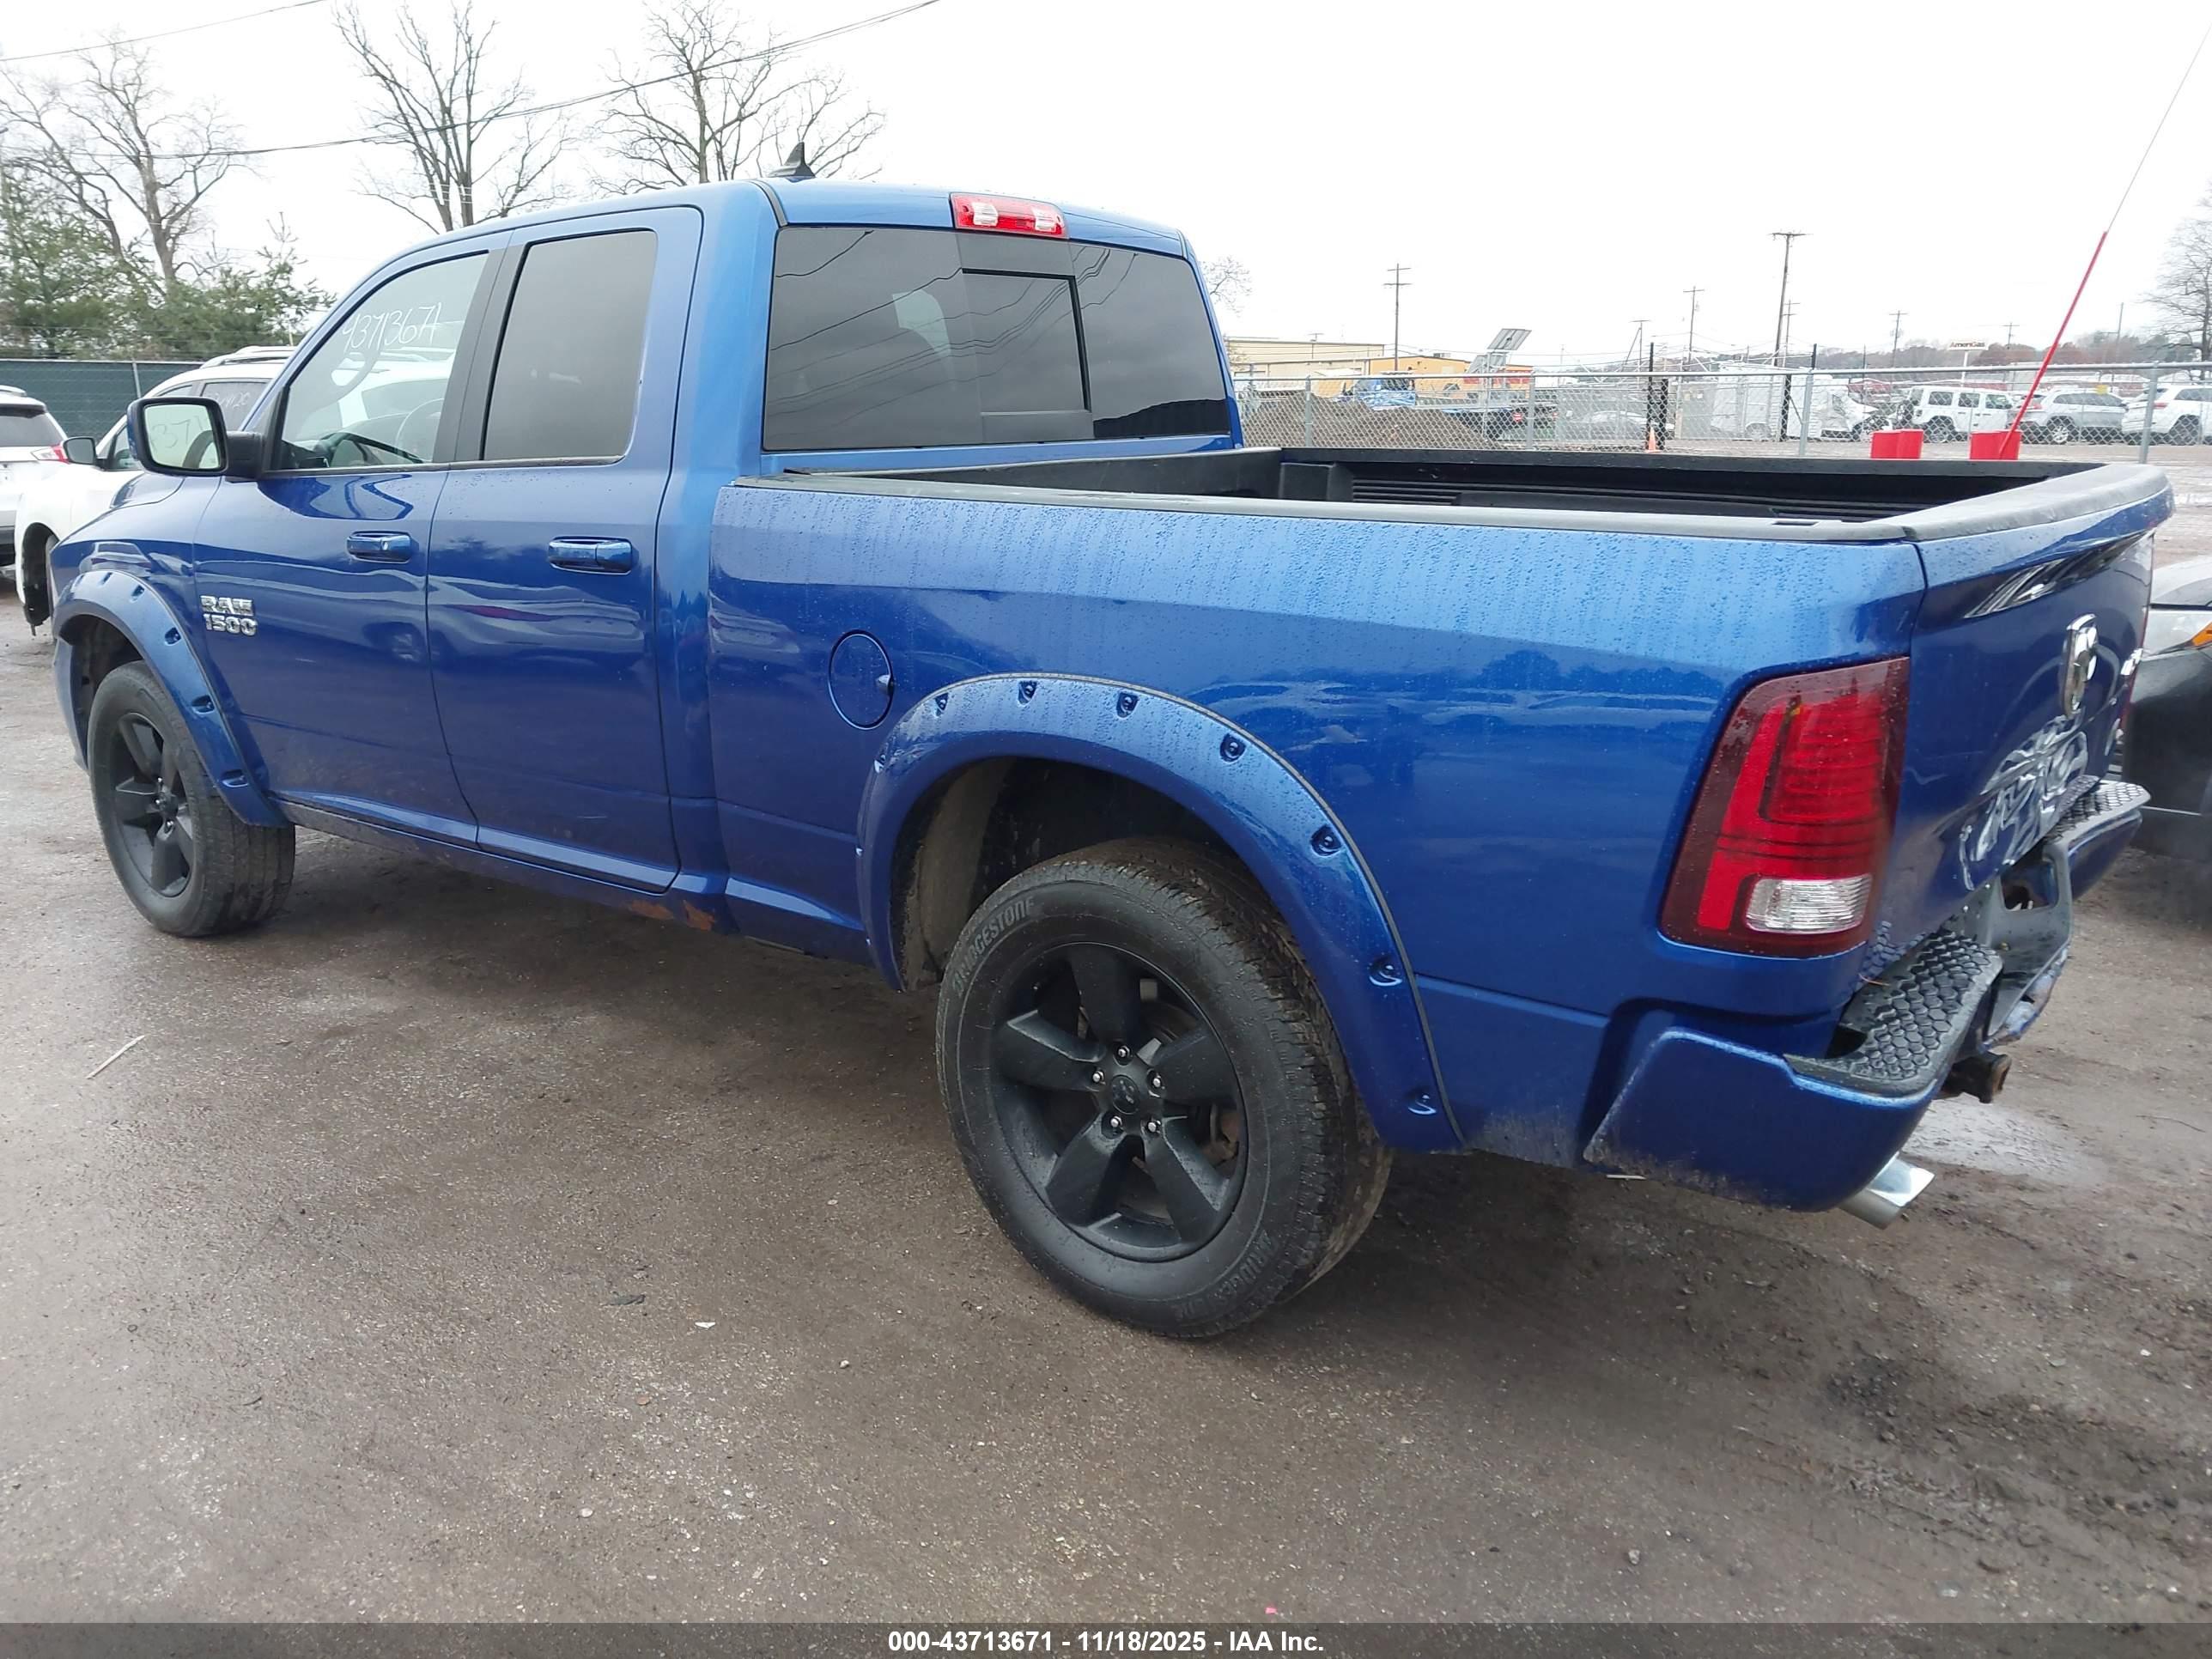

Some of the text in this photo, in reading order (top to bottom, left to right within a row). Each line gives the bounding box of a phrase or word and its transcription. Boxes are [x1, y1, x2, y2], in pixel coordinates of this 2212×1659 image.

[342, 301, 442, 353] 43713671
[200, 595, 254, 617] RAM
[203, 613, 258, 636] 1500
